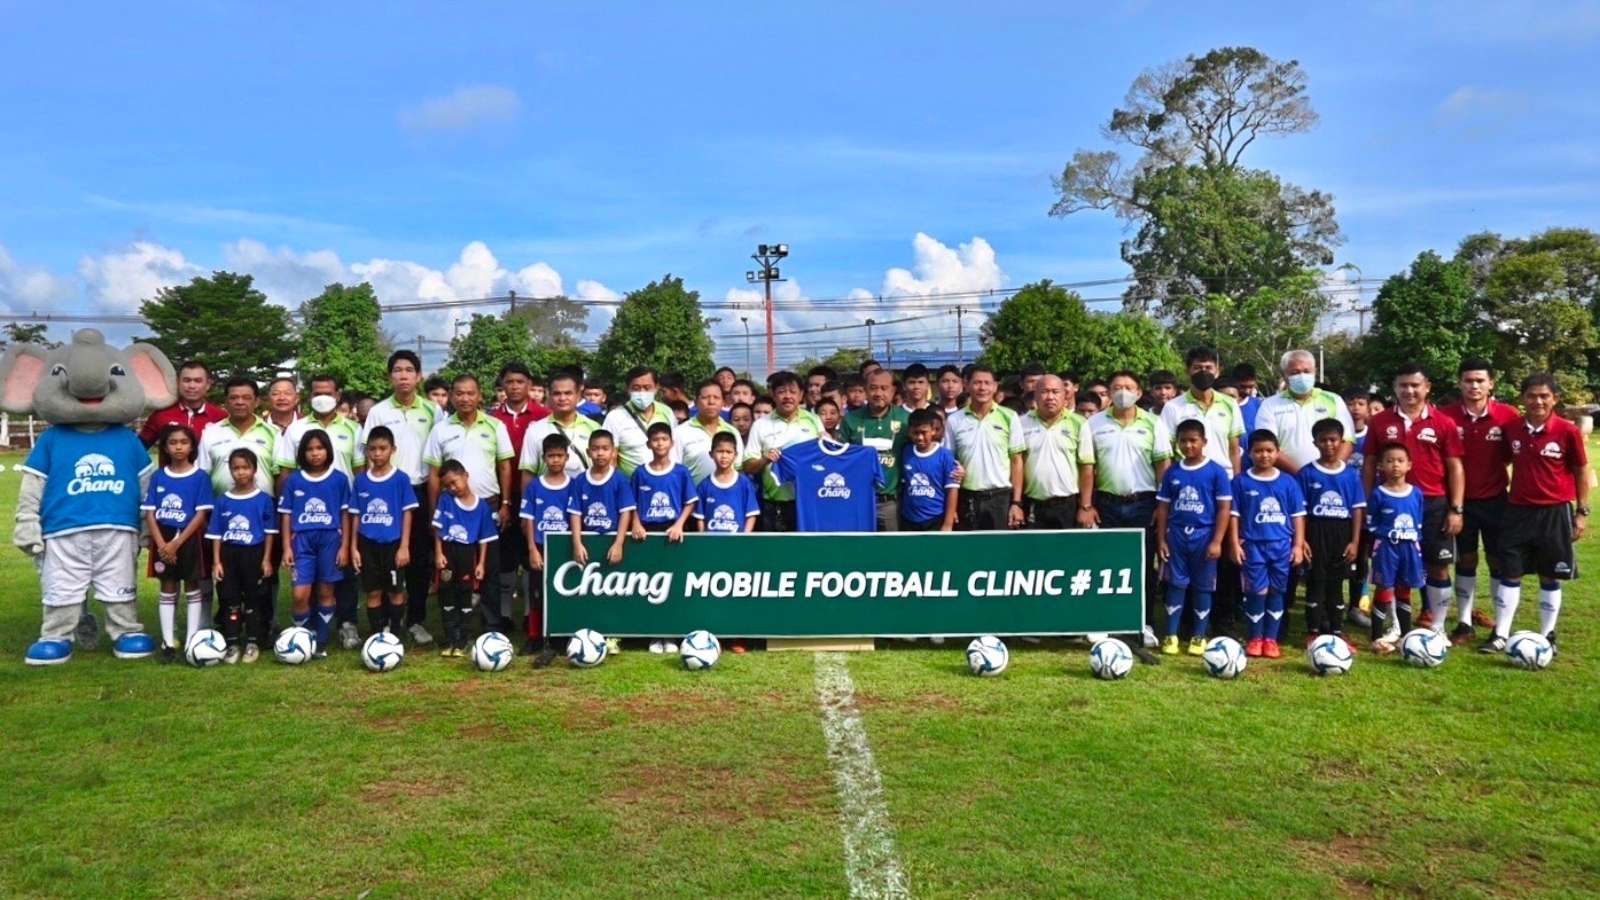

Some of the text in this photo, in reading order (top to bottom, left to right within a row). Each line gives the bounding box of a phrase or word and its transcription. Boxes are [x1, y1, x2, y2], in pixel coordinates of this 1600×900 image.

[67, 478, 125, 495] Chang
[818, 486, 851, 500] Chang
[1312, 504, 1349, 519] Chang
[298, 513, 333, 525] Chang
[361, 513, 393, 526] Chang
[537, 520, 569, 532] Chang
[552, 561, 673, 604] Chang
[684, 571, 797, 598] MOBILE
[804, 570, 959, 598] FOOTBALL
[967, 569, 1065, 597] CLINIC
